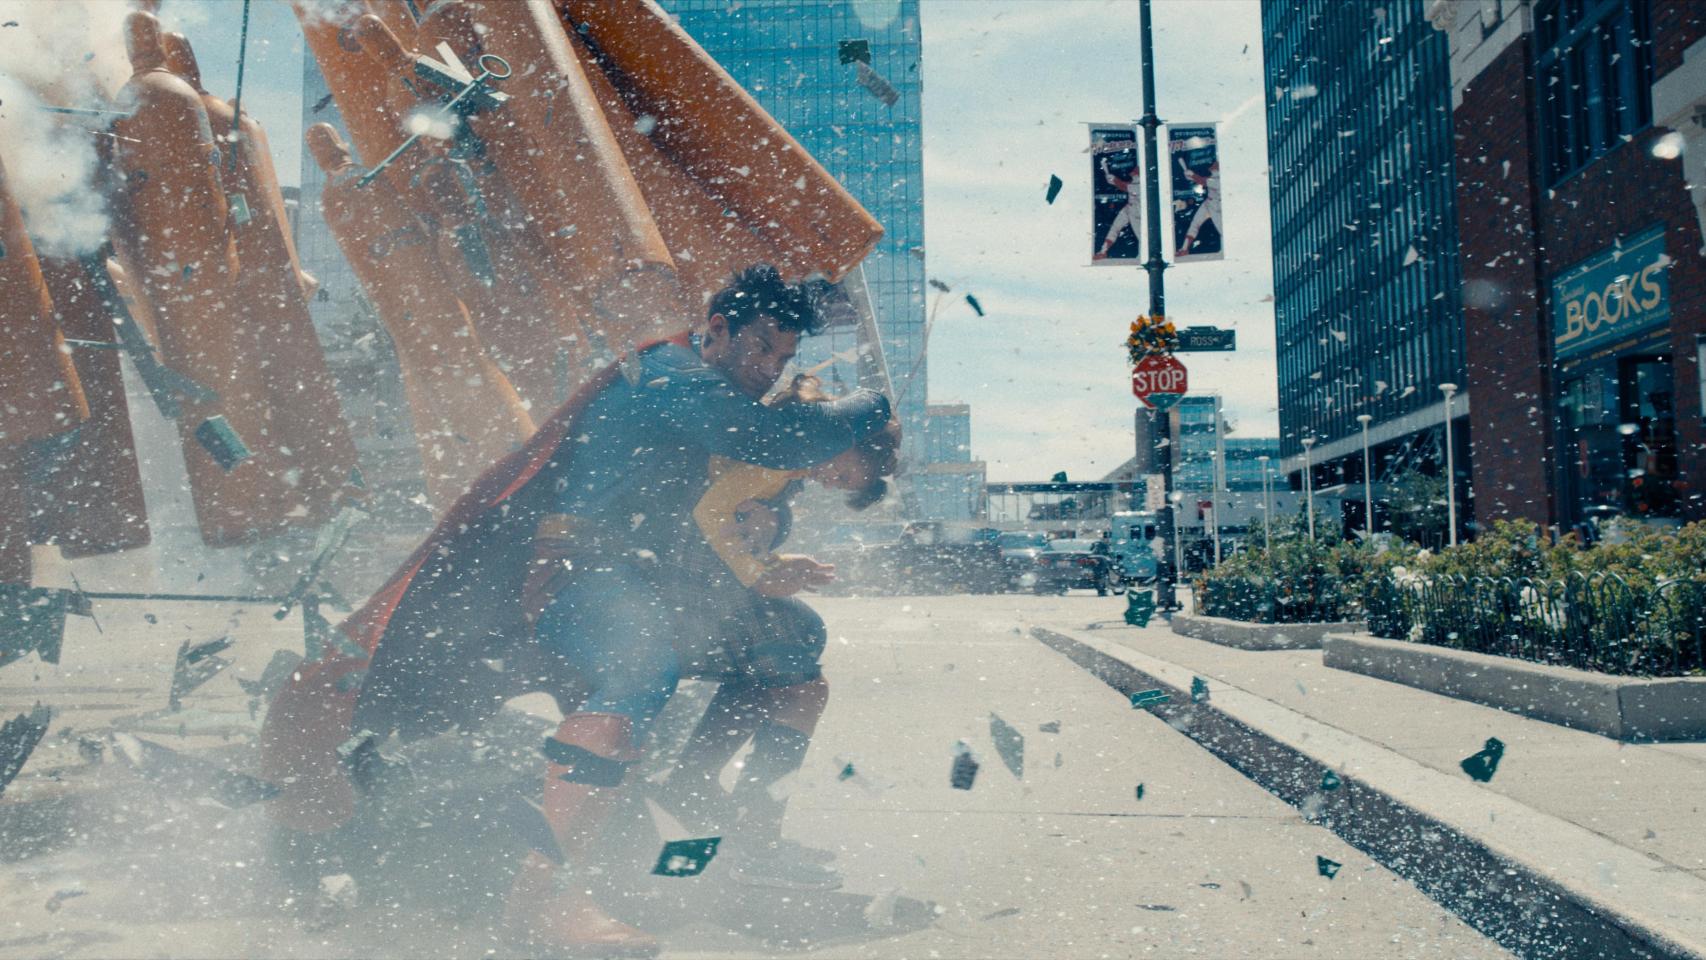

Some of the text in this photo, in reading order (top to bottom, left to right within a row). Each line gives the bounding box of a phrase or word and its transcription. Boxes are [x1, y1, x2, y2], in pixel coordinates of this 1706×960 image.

[1556, 264, 1663, 343] BOOKS
[1189, 335, 1214, 348] ROSS
[1135, 369, 1185, 392] STOP
